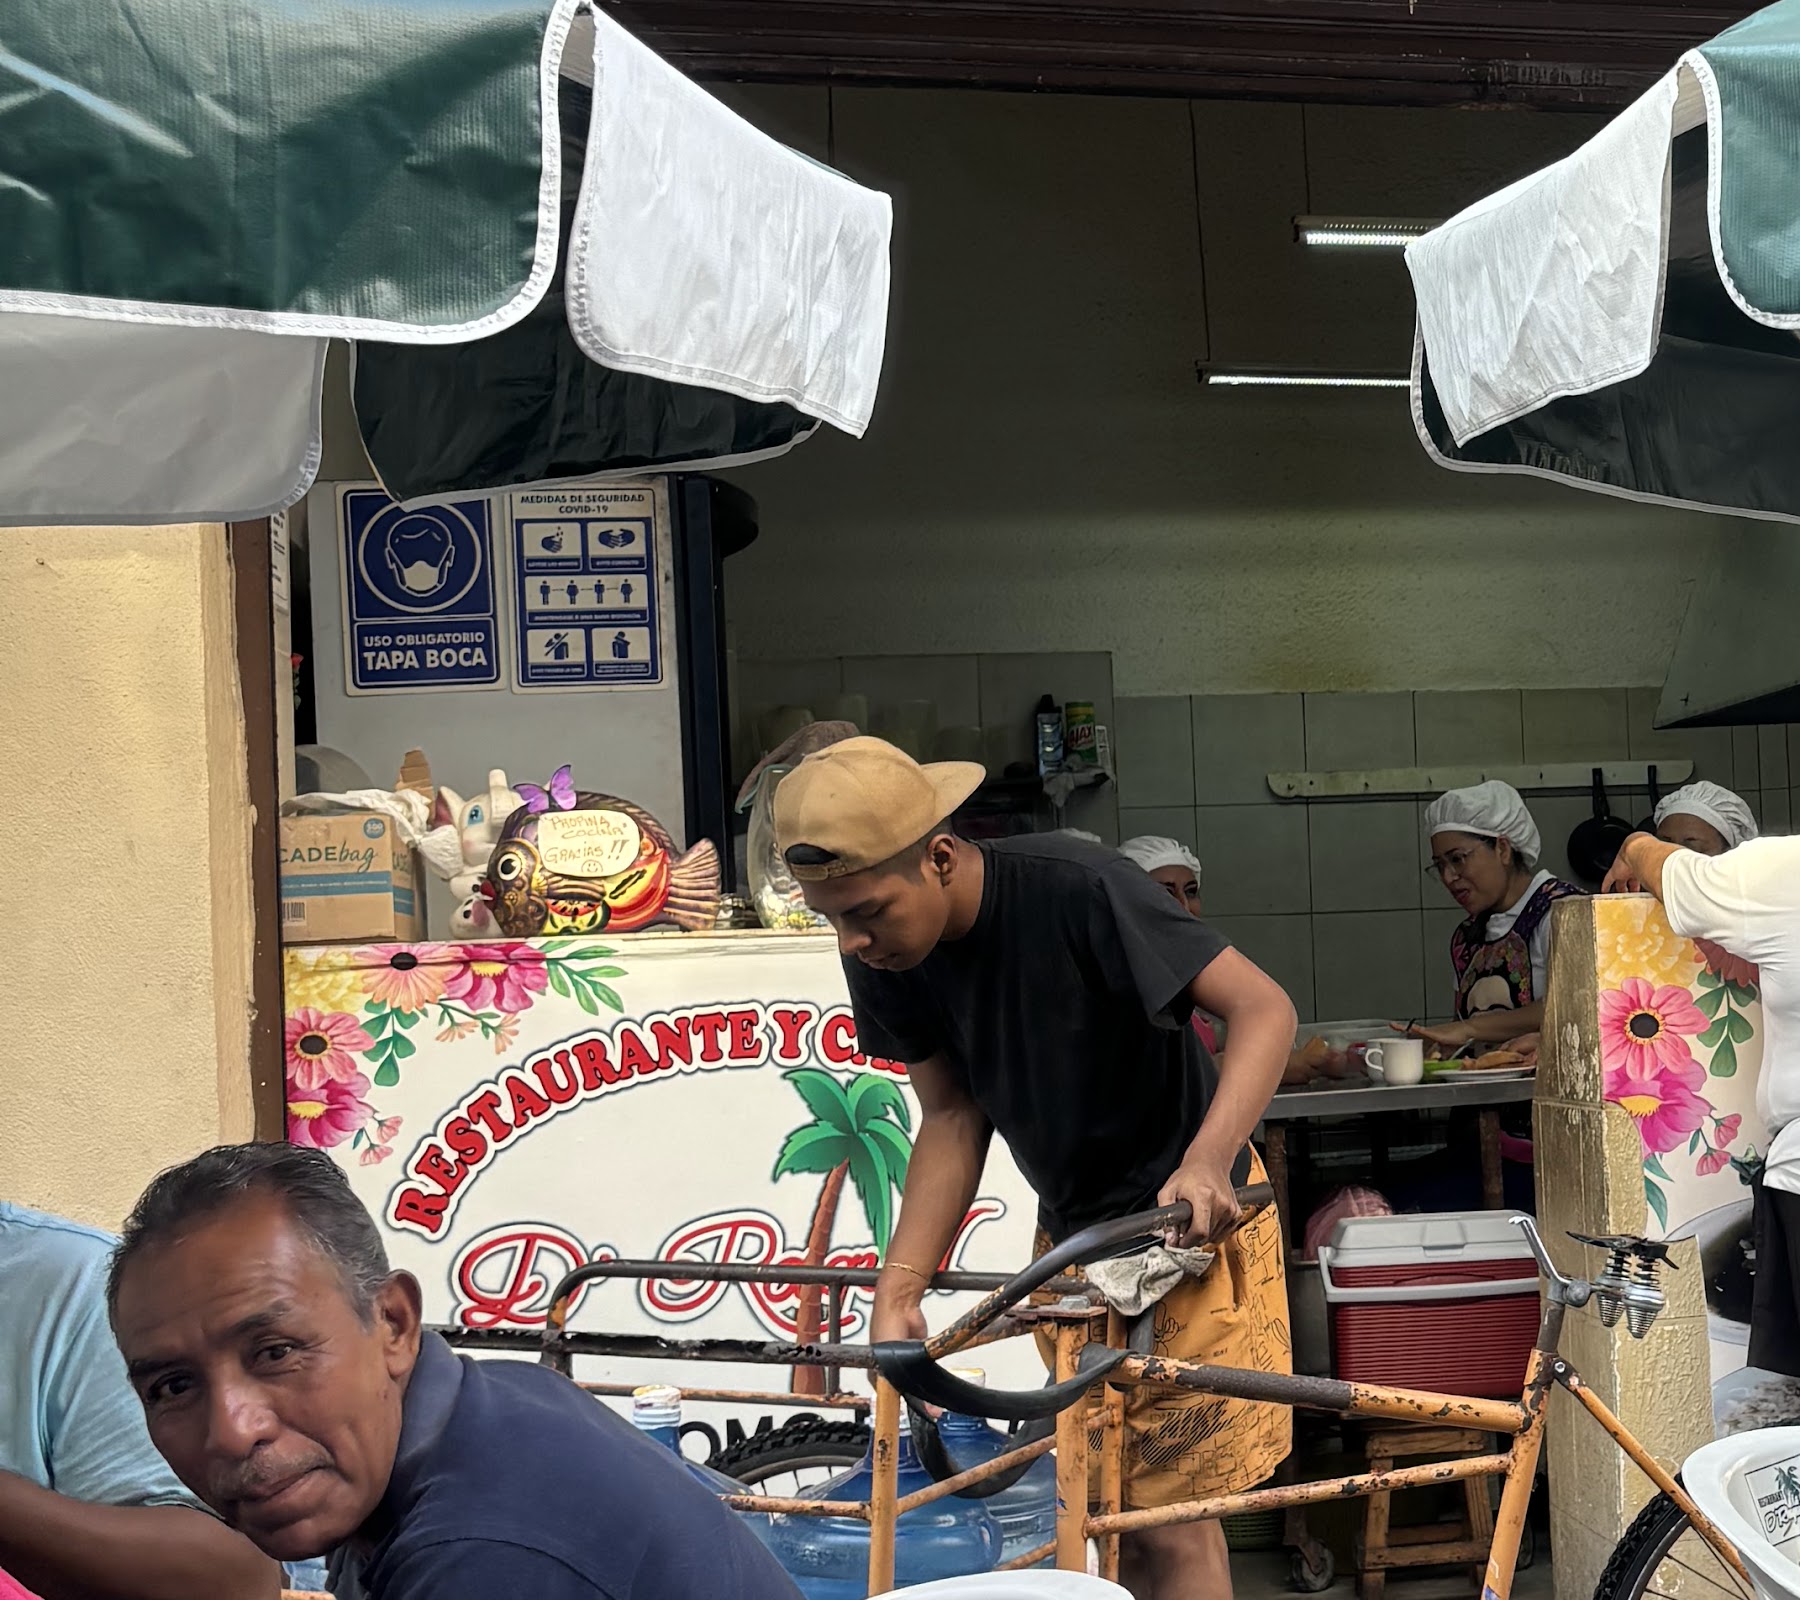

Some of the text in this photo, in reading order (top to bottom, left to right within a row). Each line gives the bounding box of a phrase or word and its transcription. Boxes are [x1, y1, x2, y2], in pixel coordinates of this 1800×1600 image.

[521, 494, 645, 503] MEDIDAS DE SEGURIDAD
[558, 505, 609, 514] COVID-19
[363, 632, 485, 647] USO OBLIGATORIO
[363, 647, 488, 670] TAPA BOCA
[394, 1010, 763, 1234] RESTAURANTE
[771, 1009, 814, 1060] Y
